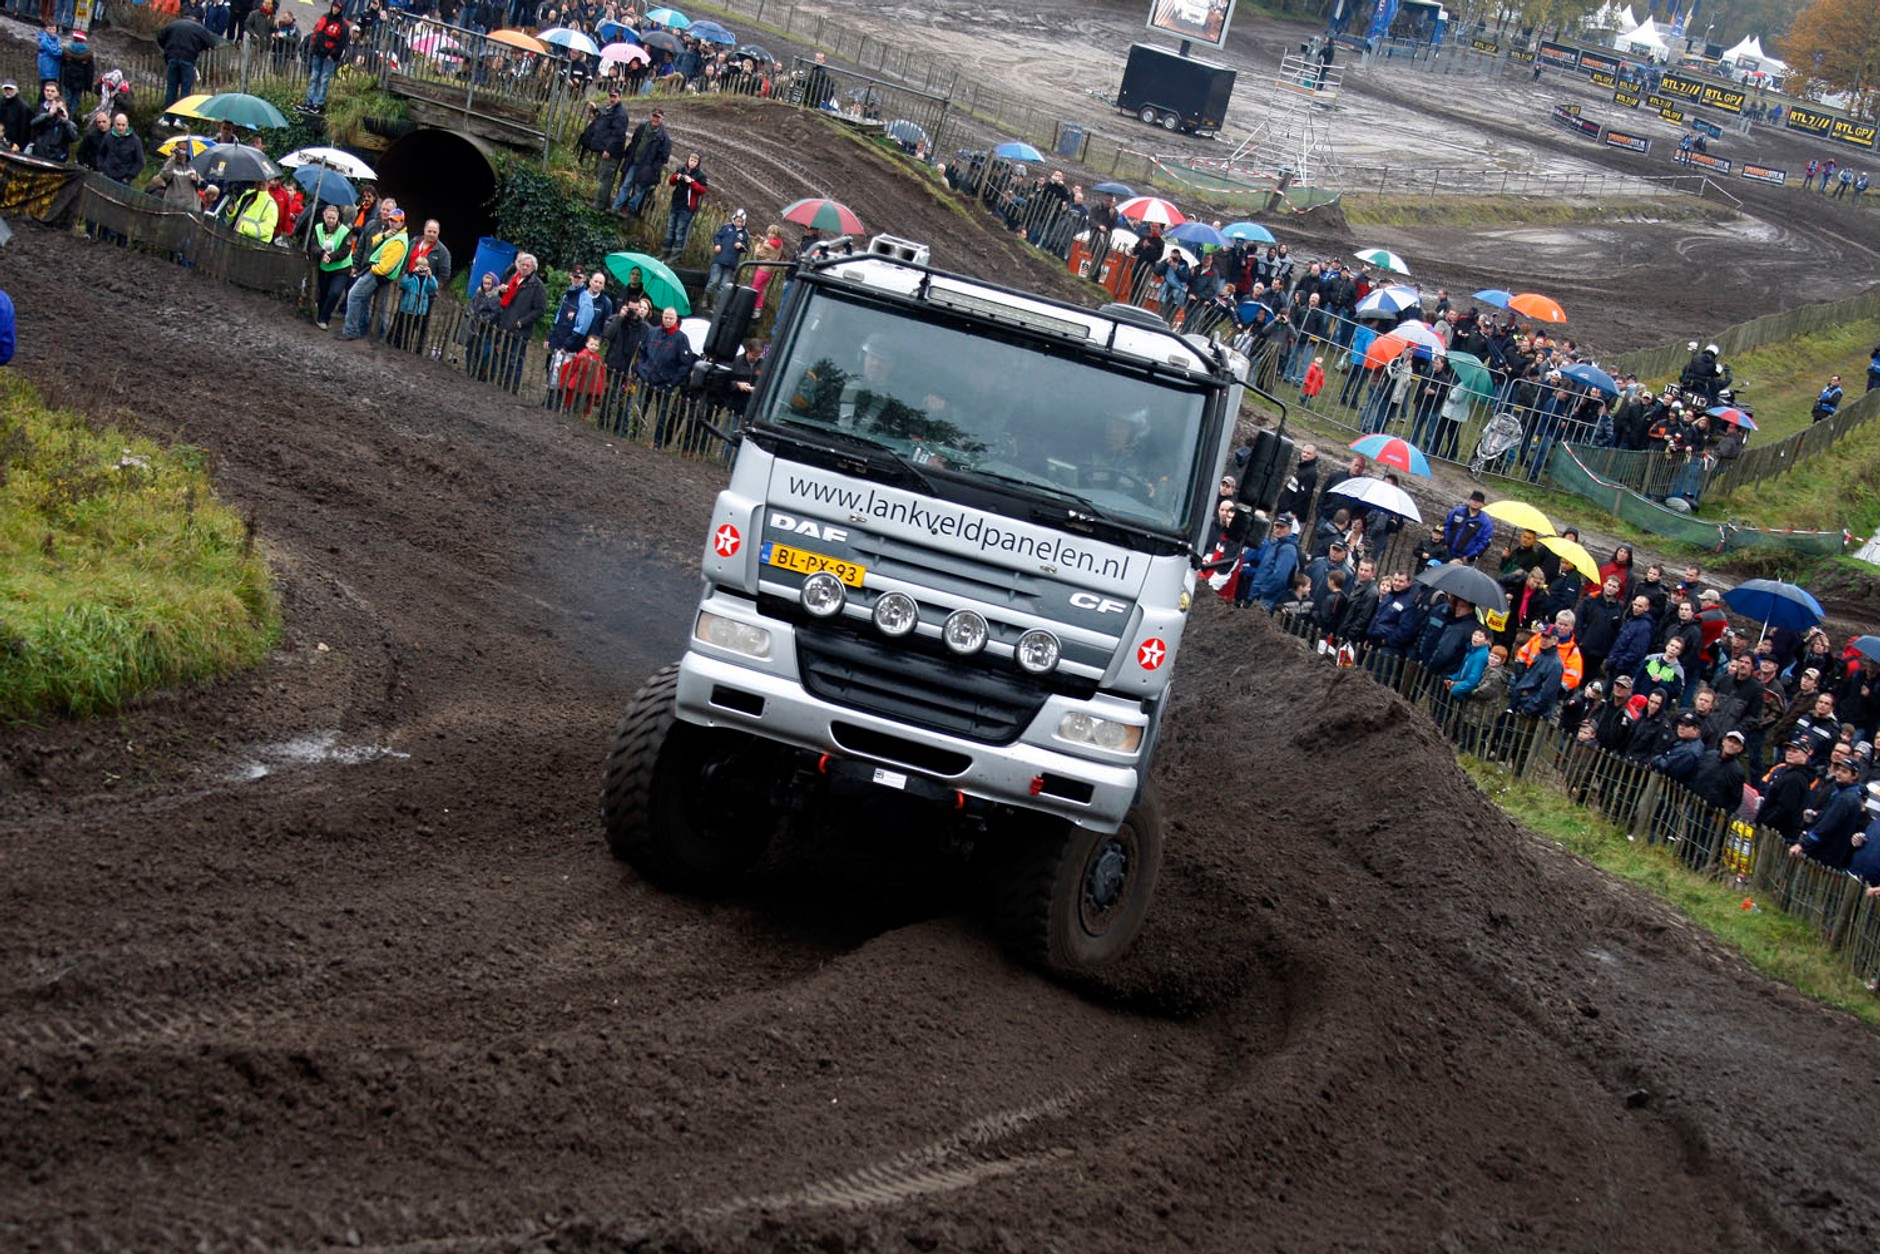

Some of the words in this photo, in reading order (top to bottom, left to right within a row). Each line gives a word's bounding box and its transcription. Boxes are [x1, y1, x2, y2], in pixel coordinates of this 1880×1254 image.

[1662, 78, 1679, 90] RTL
[1705, 89, 1722, 101] RTL
[1790, 111, 1807, 123] RTL
[1835, 121, 1854, 134] RTL
[770, 513, 848, 542] DAF
[790, 476, 1130, 580] www.lankveldpanelen.nl
[776, 549, 857, 582] BL-PX-93
[1069, 592, 1127, 613] CF
